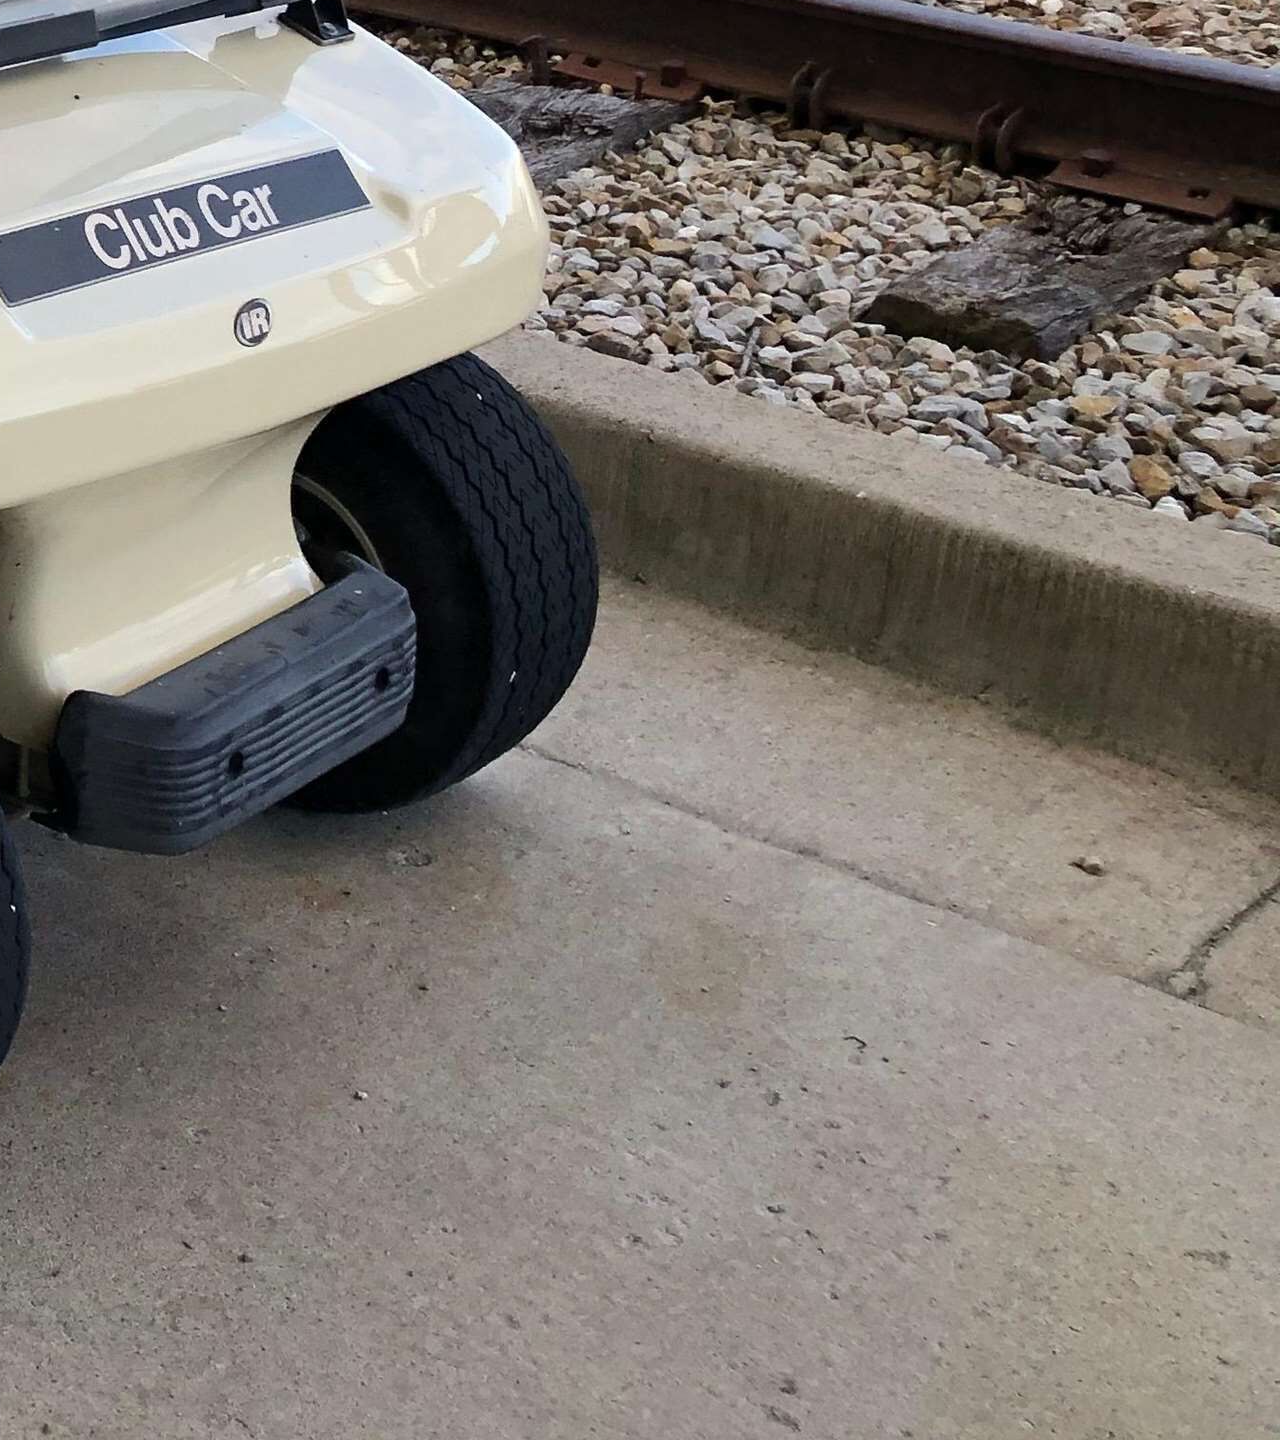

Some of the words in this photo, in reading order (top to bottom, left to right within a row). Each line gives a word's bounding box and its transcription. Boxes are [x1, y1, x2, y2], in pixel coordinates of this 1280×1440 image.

[84, 199, 200, 269] Club
[197, 184, 280, 238] Car
[240, 307, 269, 340] IR
